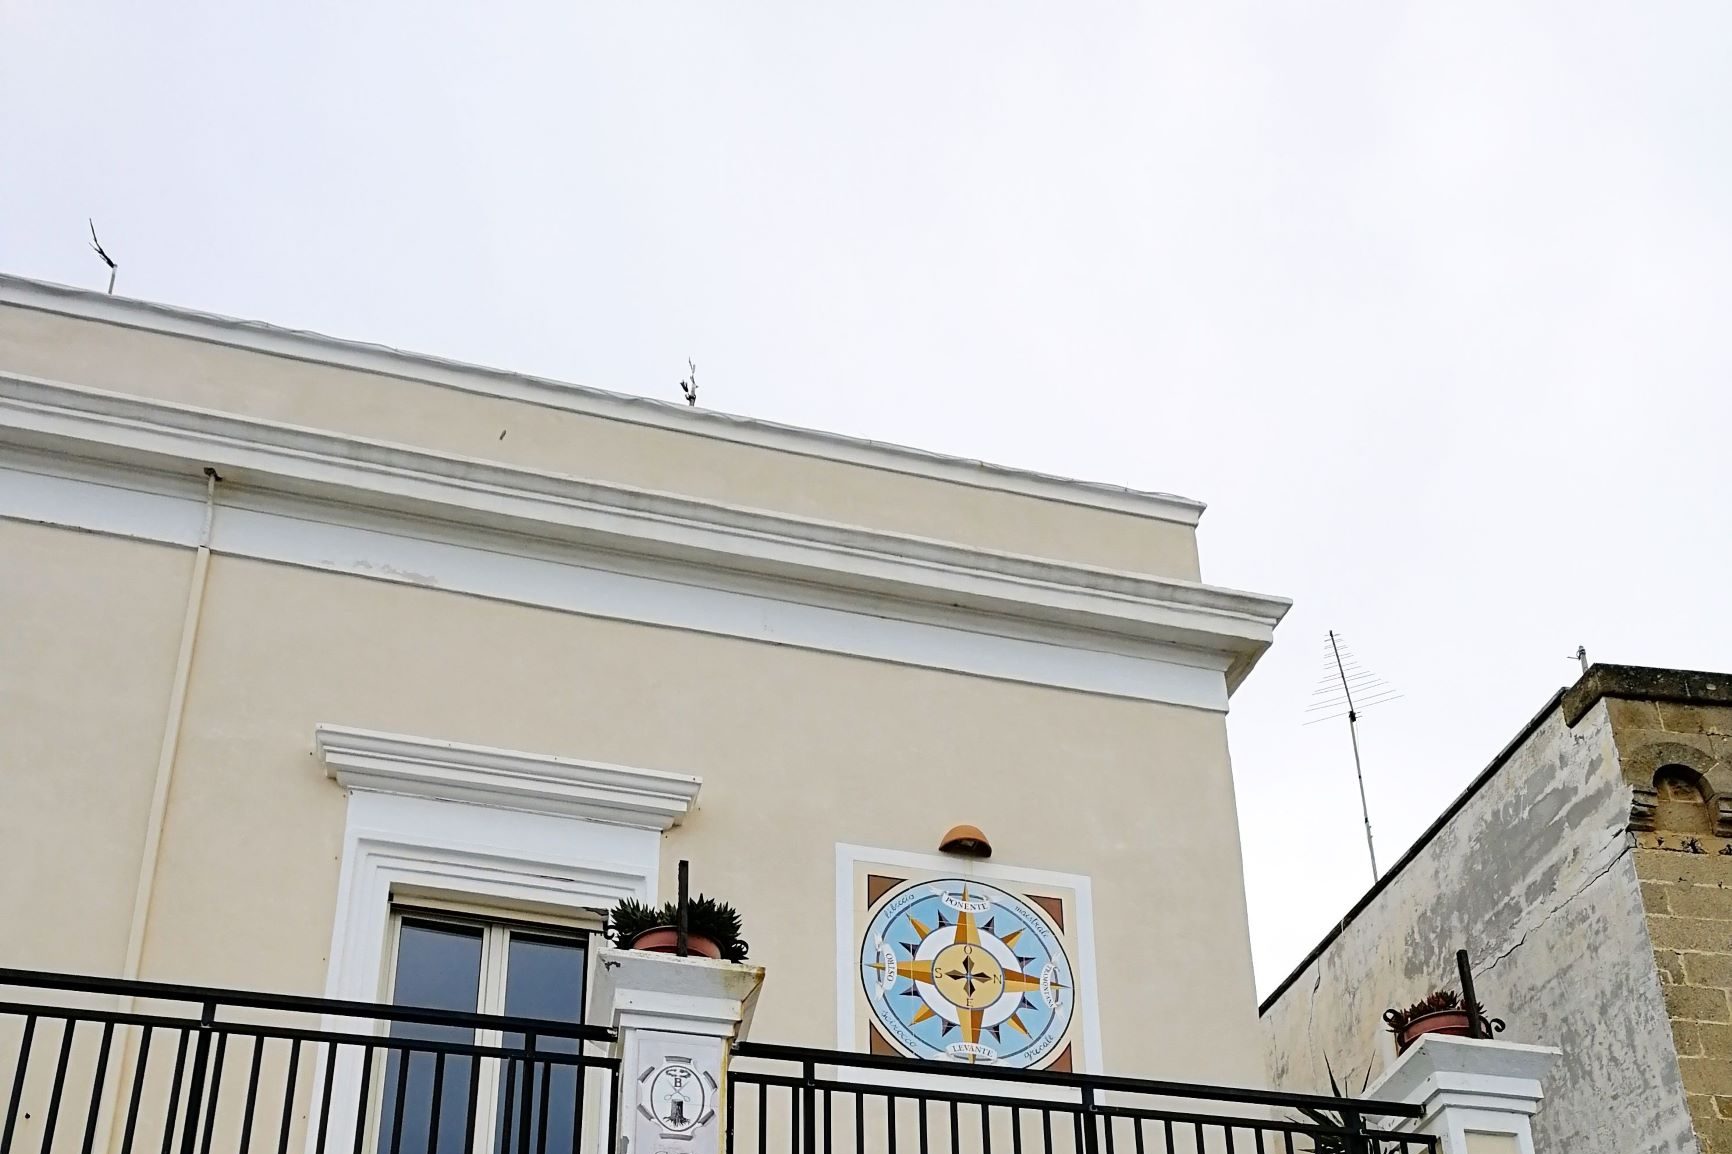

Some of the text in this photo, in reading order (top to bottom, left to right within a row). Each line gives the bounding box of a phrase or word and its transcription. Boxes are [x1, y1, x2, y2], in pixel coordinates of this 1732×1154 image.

[945, 897, 988, 911] PONENTE
[1014, 905, 1050, 938] maestrale
[963, 945, 973, 955] O
[886, 952, 896, 982] OSTRO
[934, 967, 943, 979] S
[993, 975, 1002, 985] N
[966, 998, 974, 1007] E
[952, 1045, 994, 1058] LEVANTE
[1024, 1034, 1055, 1059] grecale
[673, 1077, 683, 1088] B
